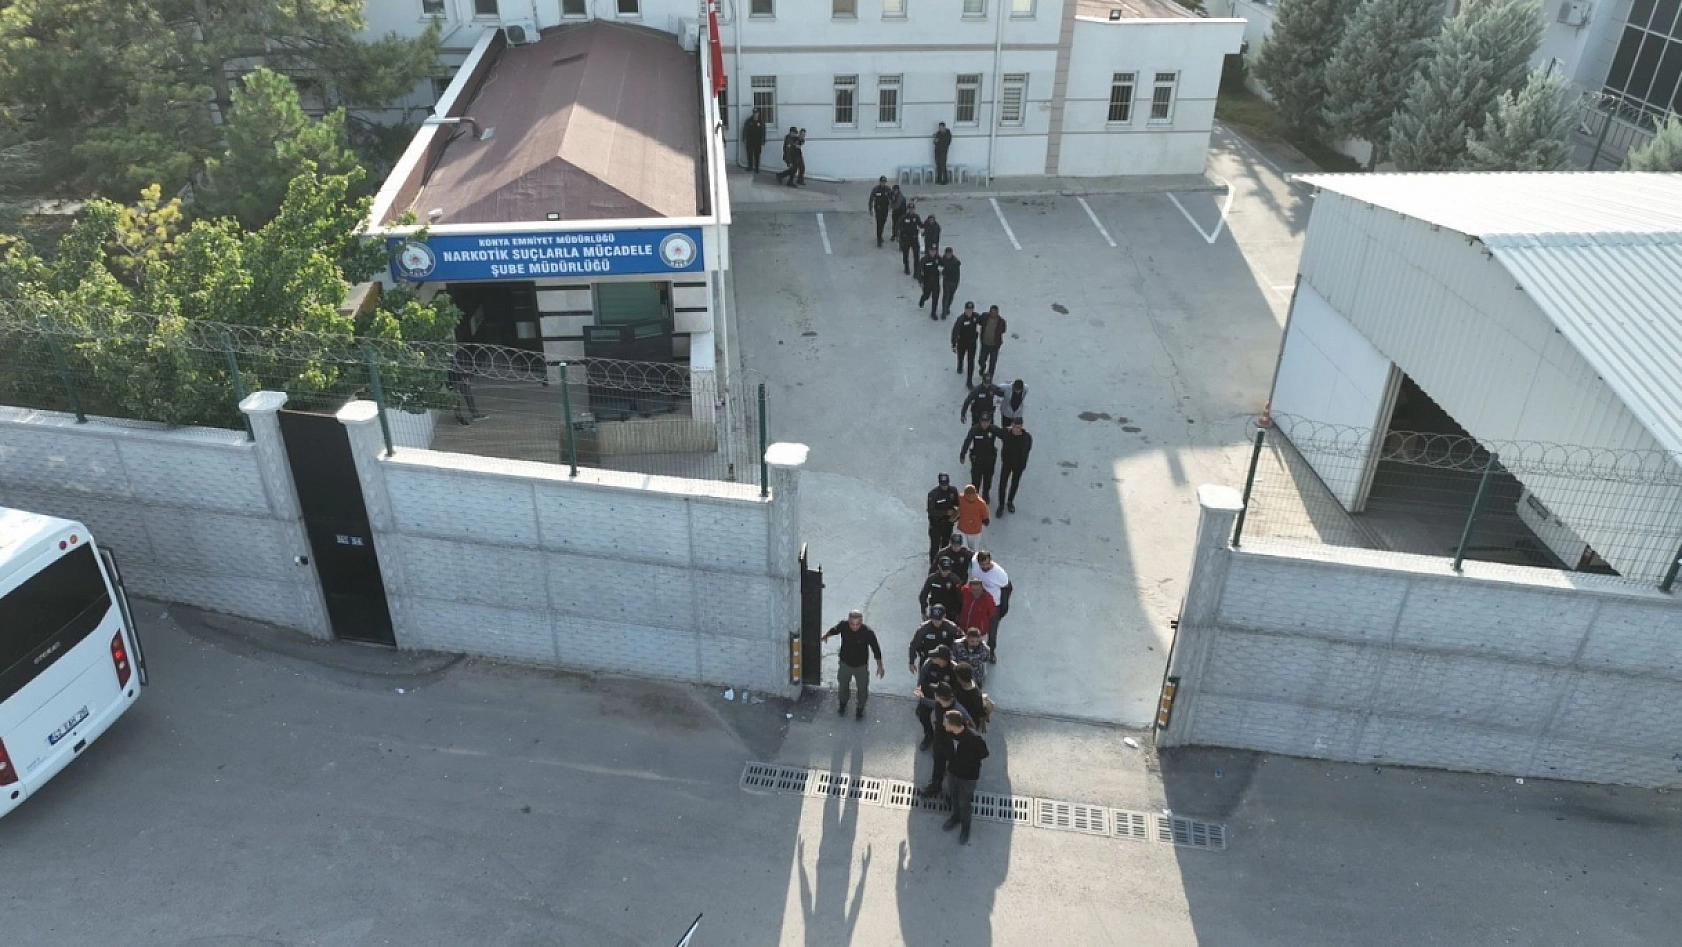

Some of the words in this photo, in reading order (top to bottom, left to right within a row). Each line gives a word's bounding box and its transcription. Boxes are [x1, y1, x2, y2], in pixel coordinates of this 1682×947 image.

[479, 238, 511, 247] KONYA
[512, 235, 554, 245] EMNİYET
[556, 232, 615, 244] MÜDÜRLÜĞÜ
[443, 247, 509, 262] NARKOTİK
[512, 247, 580, 261] SUÇLARLA
[583, 244, 653, 258] MÜCADELE
[491, 264, 526, 278] ŞUBE
[529, 258, 610, 274] MÜDÜRLÜĞÜ
